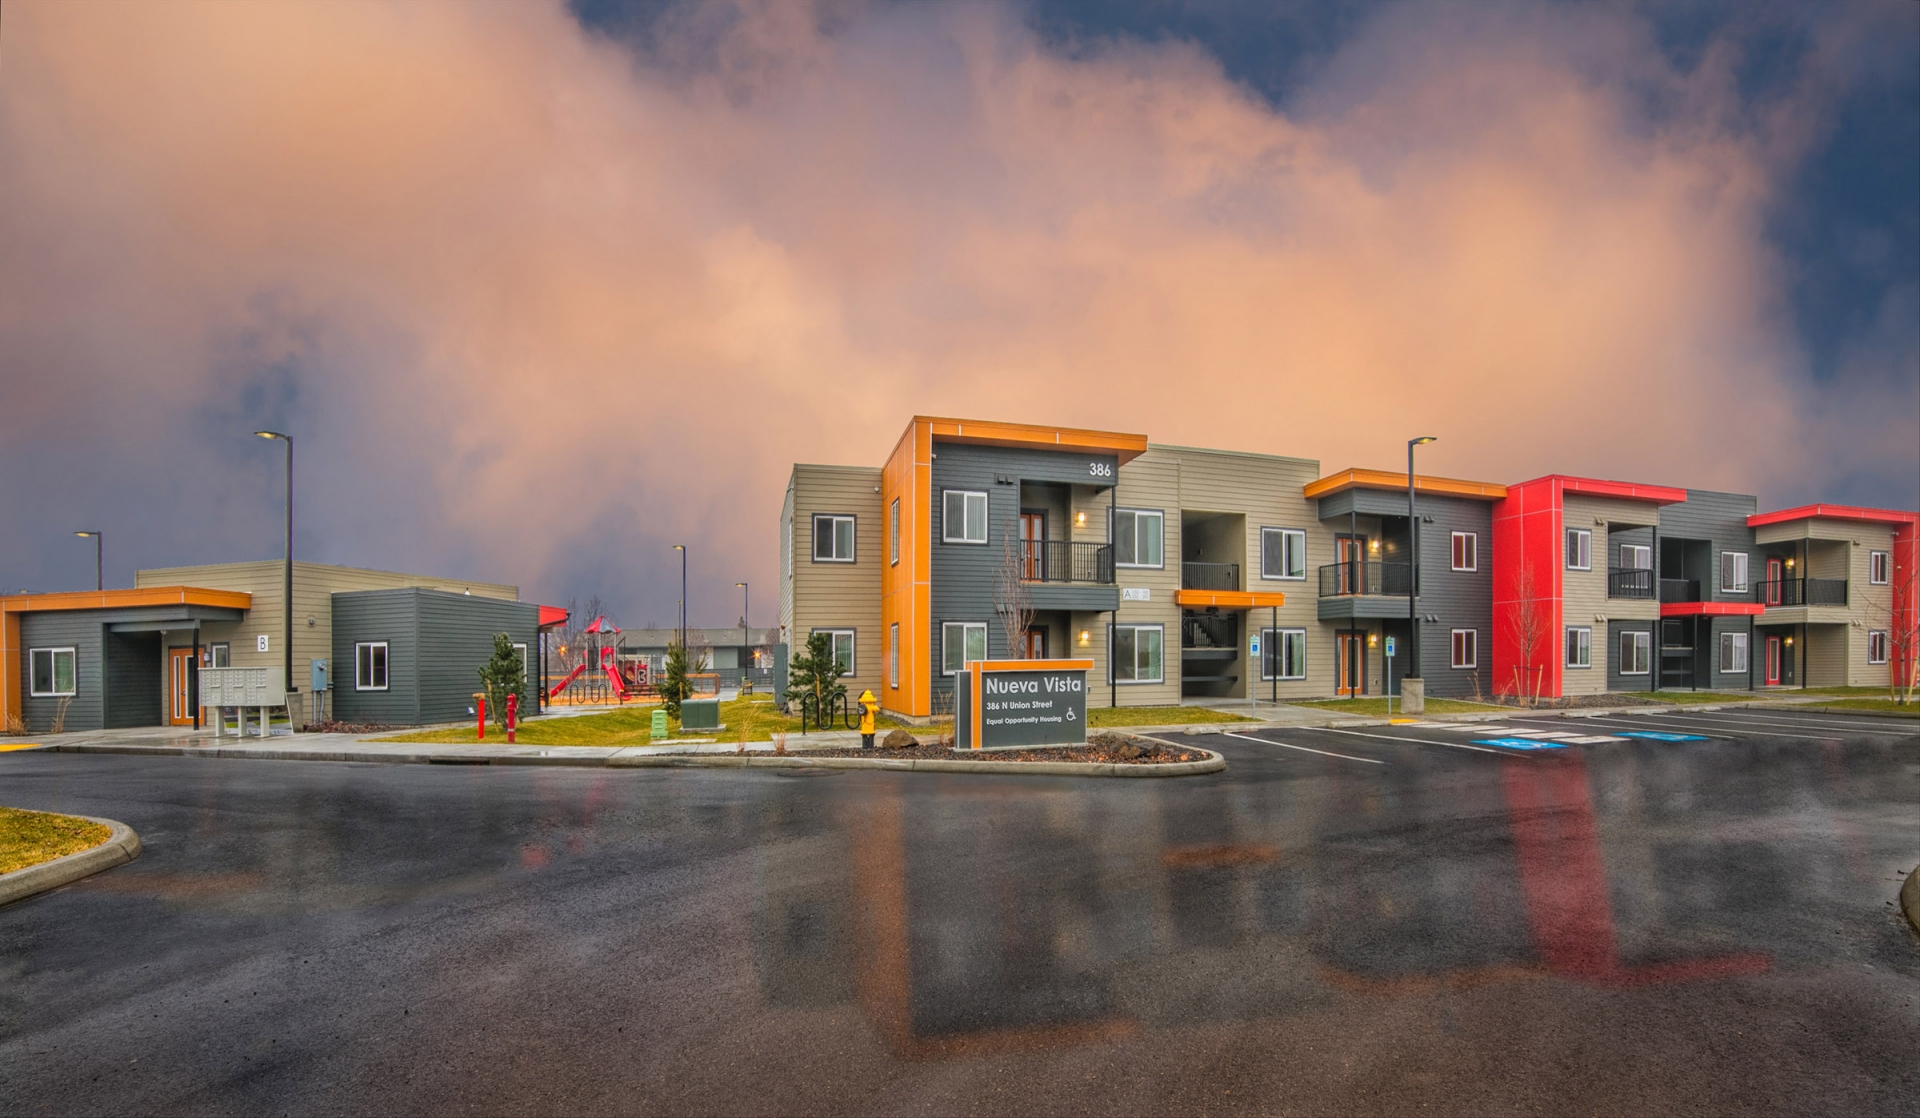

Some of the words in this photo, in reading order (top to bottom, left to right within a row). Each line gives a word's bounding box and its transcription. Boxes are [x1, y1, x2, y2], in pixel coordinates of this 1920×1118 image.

[1089, 462, 1111, 477] 386
[1124, 589, 1131, 599] A
[260, 636, 266, 650] B
[986, 678, 1038, 694] Nueva
[1044, 676, 1081, 693] Vista
[986, 702, 1000, 710] 386
[1001, 701, 1008, 710] N
[1009, 701, 1031, 709] Union
[1032, 700, 1053, 709] Street
[986, 718, 1004, 726] Equal
[1004, 716, 1039, 724] Opportunity
